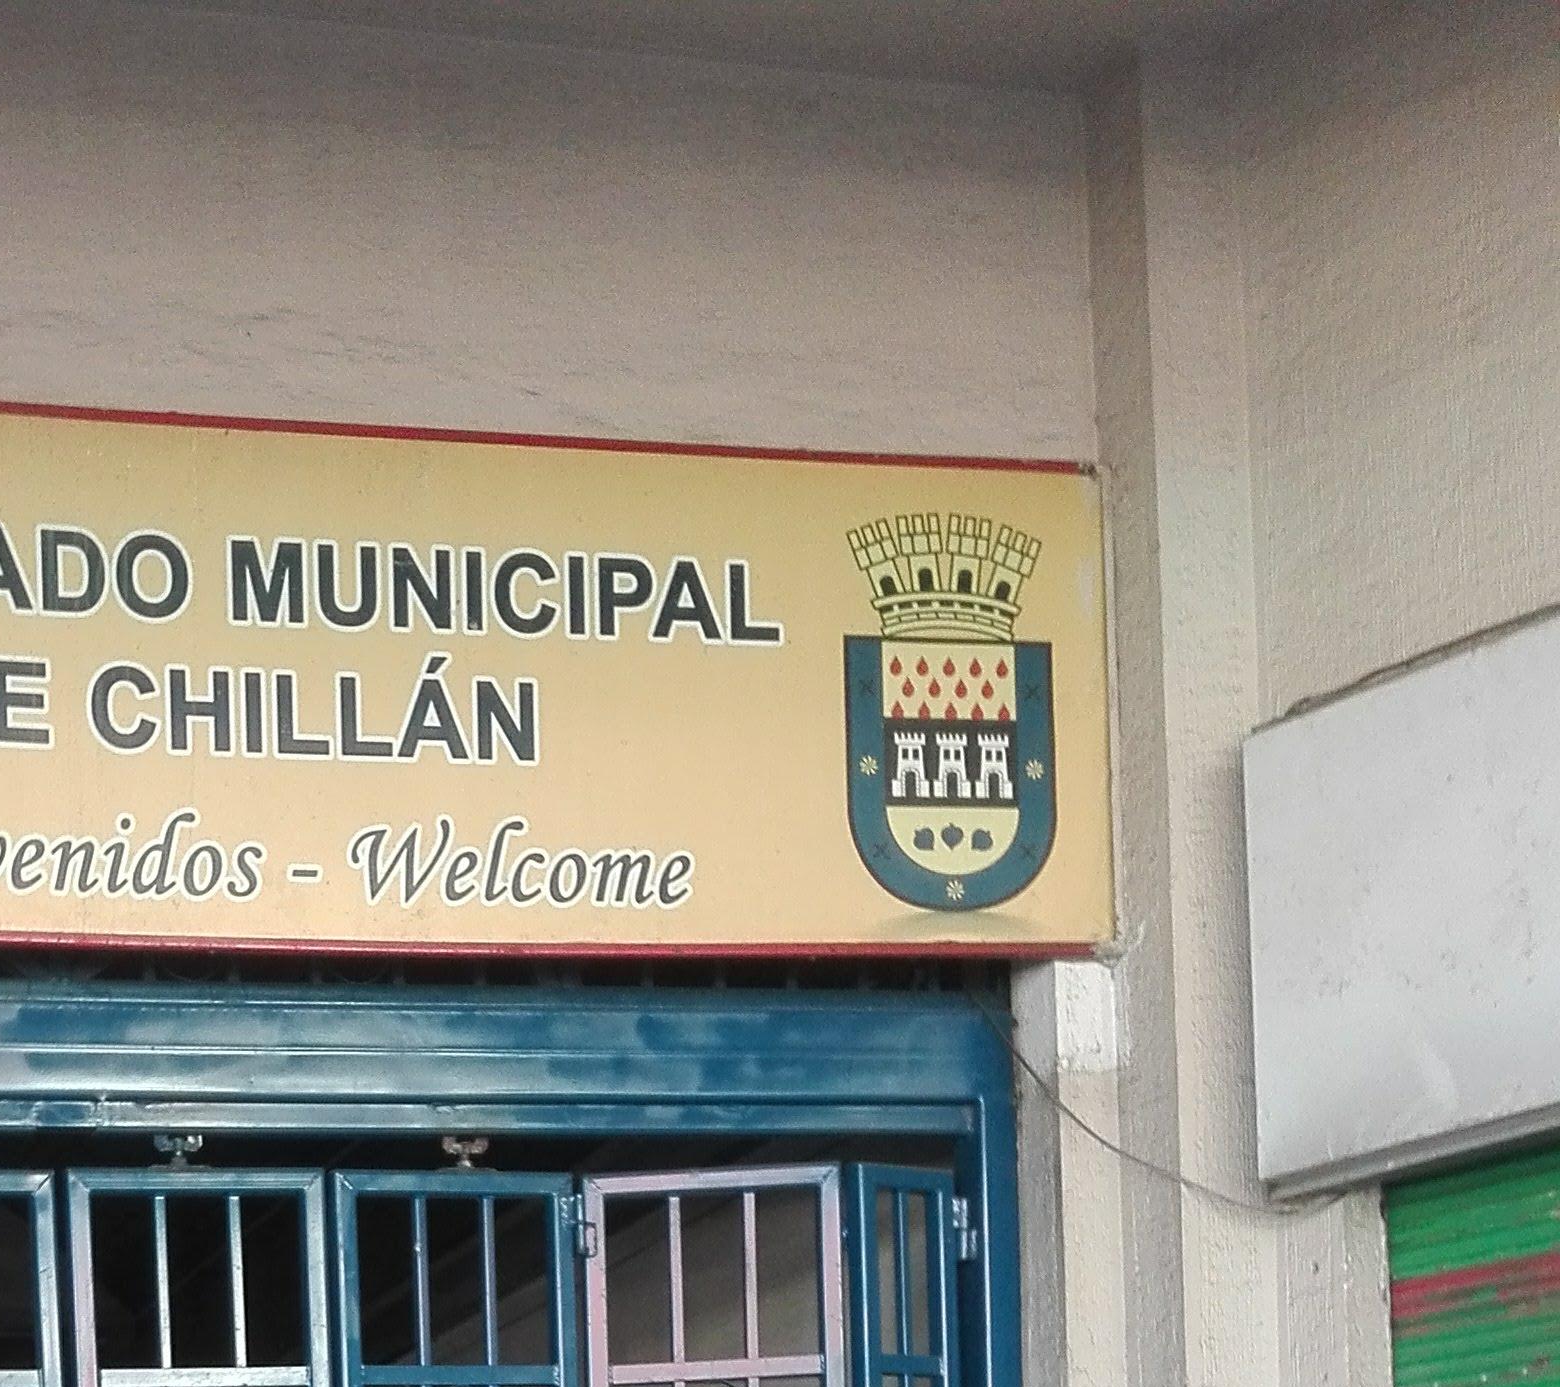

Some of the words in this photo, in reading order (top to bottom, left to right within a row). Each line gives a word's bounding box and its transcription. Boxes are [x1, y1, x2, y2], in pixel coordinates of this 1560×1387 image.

[228, 536, 783, 644] MUNICIPAL
[90, 654, 539, 763] CHILLÁN
[348, 819, 695, 907] Welcome
